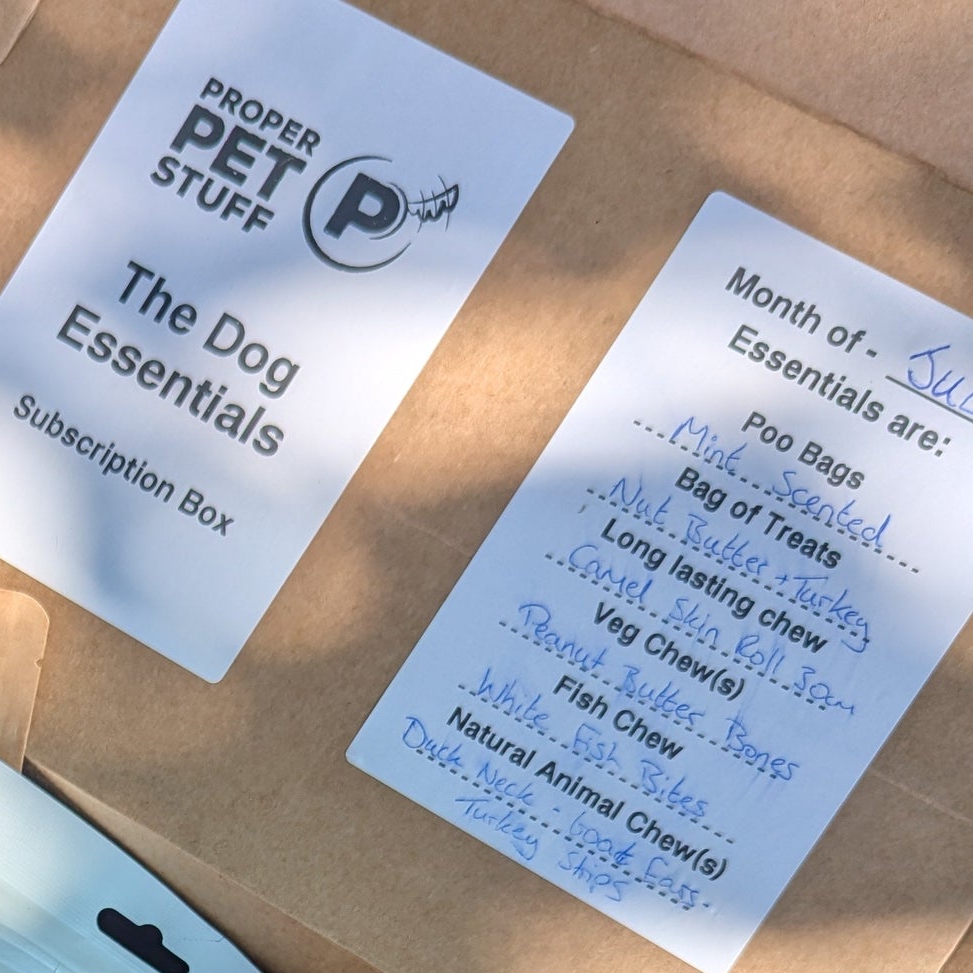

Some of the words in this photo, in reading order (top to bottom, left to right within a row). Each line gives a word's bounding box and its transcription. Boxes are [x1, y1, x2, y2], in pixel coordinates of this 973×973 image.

[170, 104, 307, 202] PET
[200, 77, 321, 157] PROPER
[150, 156, 275, 233] STUFF
[323, 172, 401, 239] P
[118, 260, 198, 336] The
[202, 312, 300, 399] Dog
[725, 267, 822, 334] Month
[826, 325, 866, 354] of
[56, 304, 285, 457] Essentials
[727, 324, 884, 423] Essentials
[887, 413, 951, 457] are:
[13, 394, 175, 503] Subscription
[177, 488, 234, 537] Box
[670, 416, 748, 473] Mint
[772, 471, 891, 548] Scented
[741, 411, 794, 453] Poo
[797, 441, 865, 490] Bags
[610, 477, 672, 526] Nut
[686, 513, 769, 577] Butter
[675, 467, 728, 513] Bag
[729, 501, 763, 526] of
[763, 511, 842, 569] Treats
[568, 544, 653, 603] Camel
[667, 597, 720, 645] Skin
[733, 633, 785, 675] Roll
[600, 518, 667, 572] Long
[668, 556, 755, 618] lasting
[759, 608, 828, 654] chew
[518, 603, 605, 670] Peanut
[623, 664, 705, 726] Butter
[725, 714, 800, 783] Bones
[593, 602, 640, 647] Veg
[644, 632, 746, 701] Chew(s)
[402, 716, 464, 770] Duck
[476, 762, 534, 807] Neck
[477, 667, 549, 732] White
[572, 723, 622, 768] Fish
[639, 760, 709, 819] Bites
[553, 675, 610, 720] Fish
[613, 709, 684, 761] Chew
[445, 706, 537, 769] Natural
[534, 761, 626, 821] Animal
[626, 811, 727, 882] Chew(s)
[454, 798, 539, 861] Turkey
